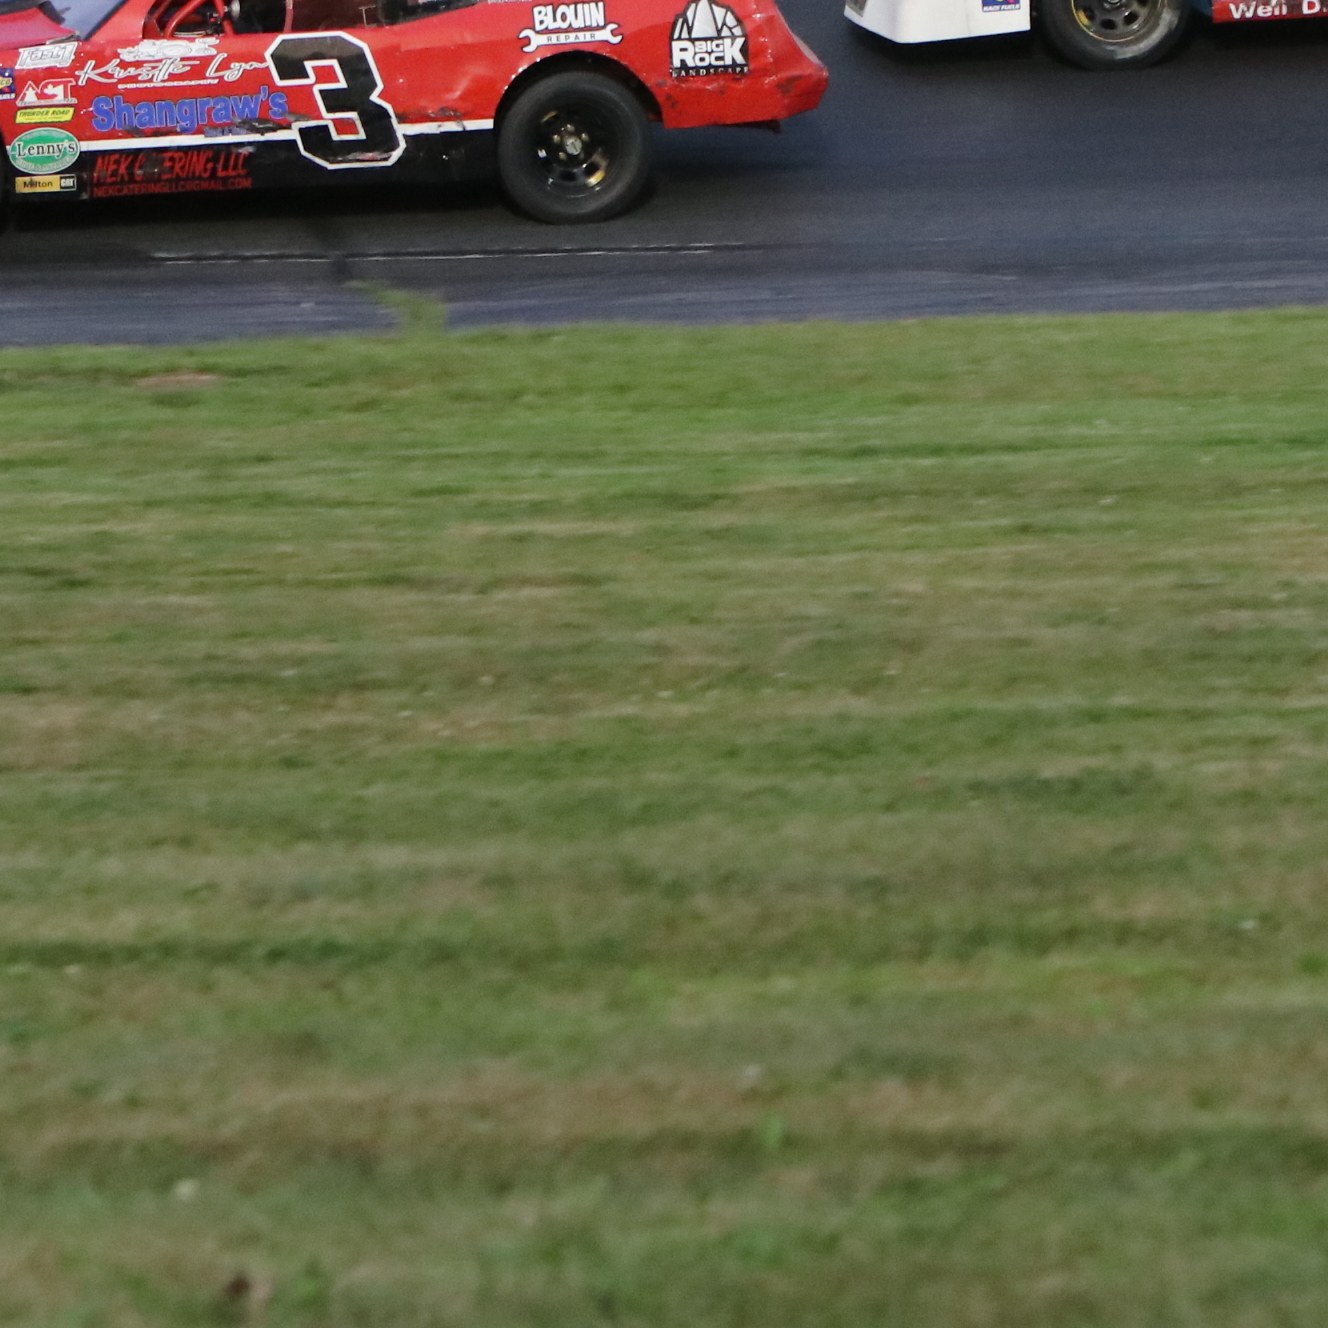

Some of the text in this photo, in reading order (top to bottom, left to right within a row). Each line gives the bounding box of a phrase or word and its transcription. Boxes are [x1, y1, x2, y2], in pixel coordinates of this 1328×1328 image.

[532, 1, 605, 32] BLOUIN
[547, 33, 597, 43] REPAIR
[672, 37, 746, 69] ROCK
[695, 40, 724, 53] BIG
[672, 66, 750, 78] LANDSCAPE
[92, 85, 289, 134] Shangraw's
[263, 30, 407, 170] 3
[16, 142, 76, 158] Lenny's
[93, 153, 134, 183] NEK
[217, 150, 251, 178] LLC
